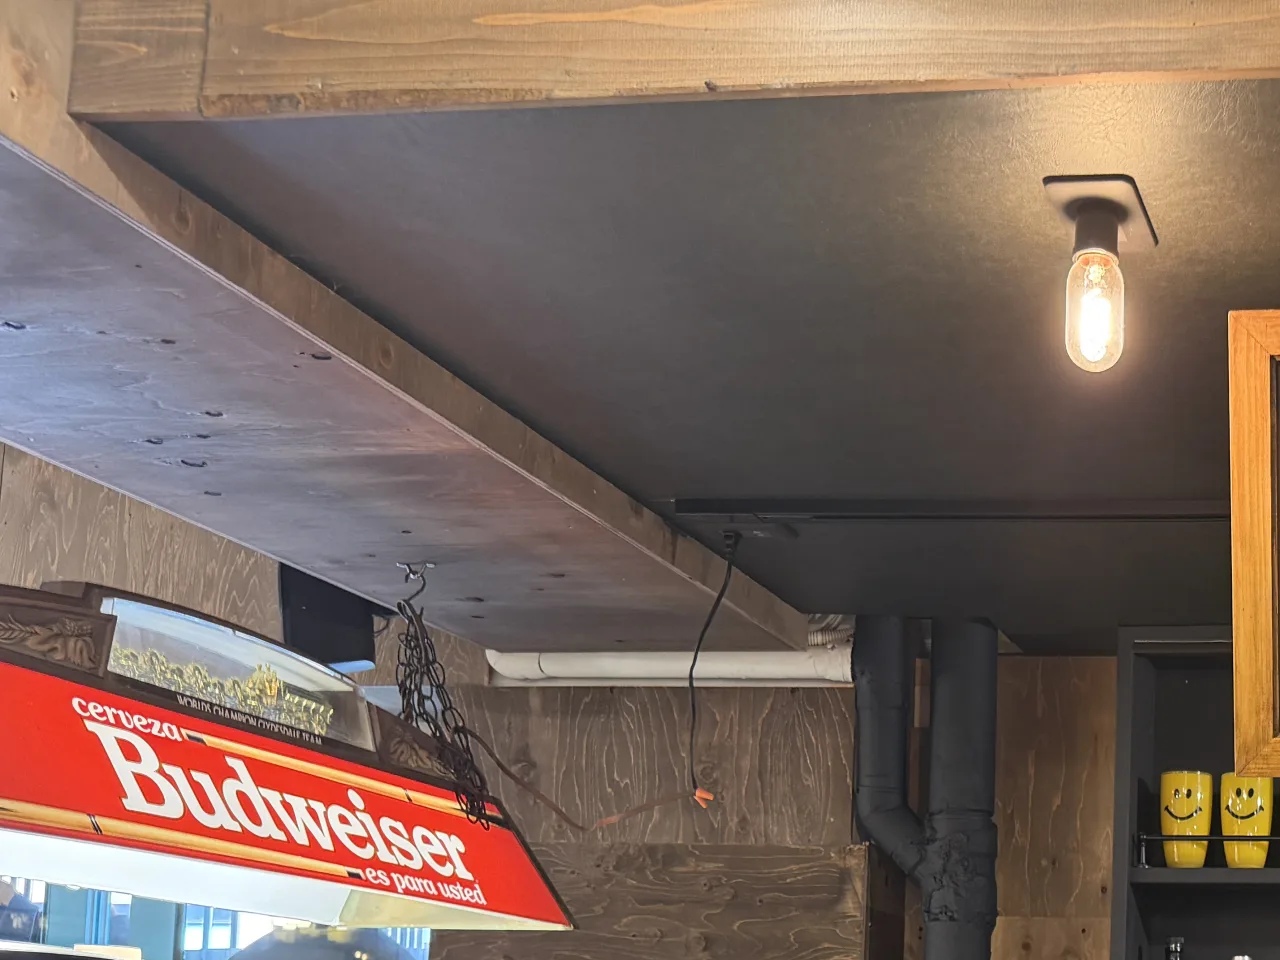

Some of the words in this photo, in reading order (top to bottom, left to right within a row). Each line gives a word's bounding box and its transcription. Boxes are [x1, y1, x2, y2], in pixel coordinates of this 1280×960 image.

[71, 697, 183, 742] cerveza
[213, 706, 257, 727] CHAMPION
[302, 732, 322, 745] TEAM
[83, 718, 475, 882] Budweiser
[365, 867, 391, 886] es
[390, 872, 438, 896] para
[437, 881, 487, 906] usted
